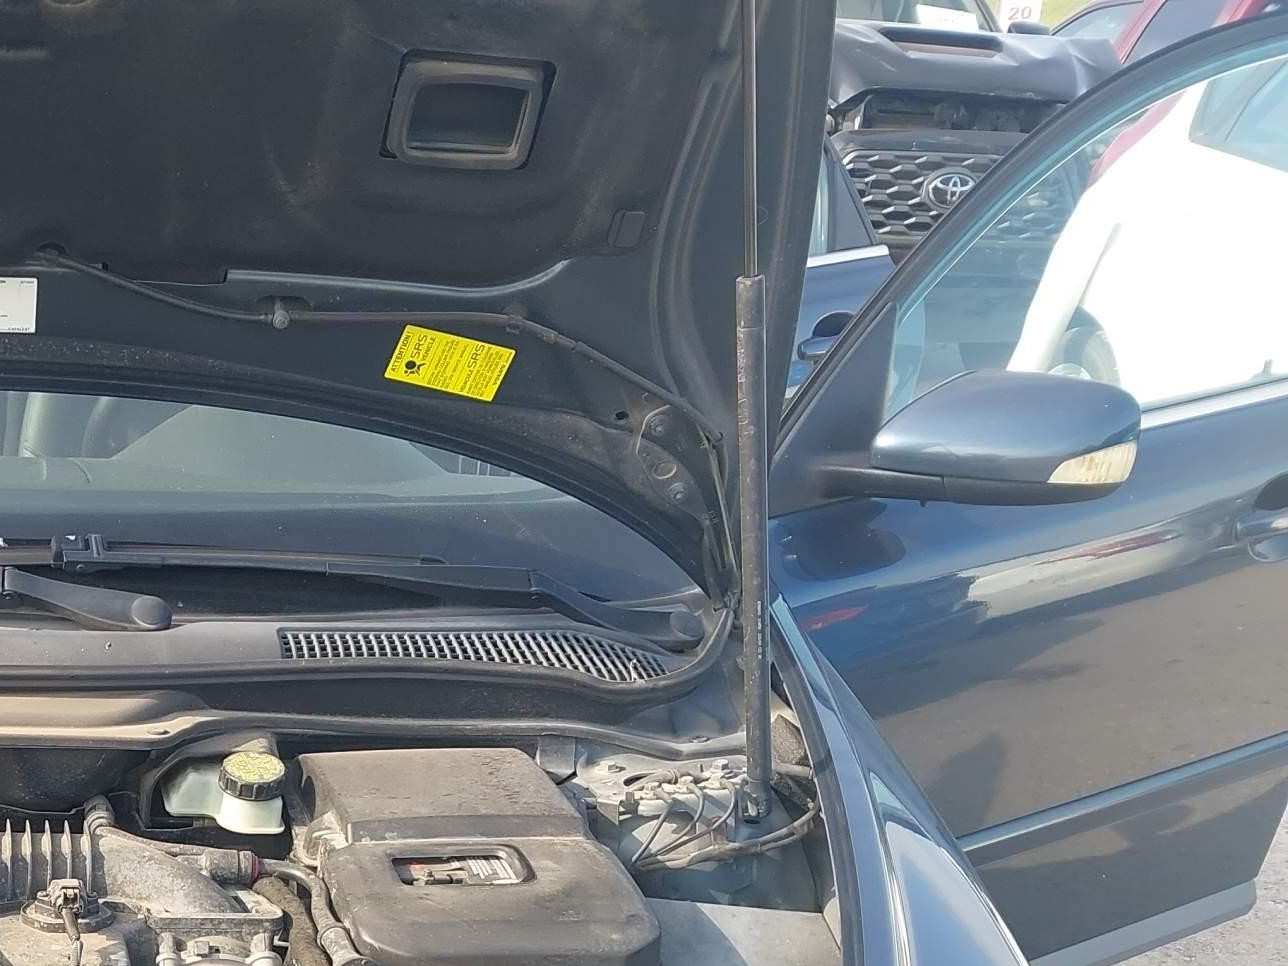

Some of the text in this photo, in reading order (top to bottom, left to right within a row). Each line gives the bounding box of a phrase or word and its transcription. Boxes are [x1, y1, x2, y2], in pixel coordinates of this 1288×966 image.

[1008, 6, 1032, 20] 20
[392, 335, 411, 372] ATTENTION
[411, 334, 428, 359] SRS
[467, 344, 485, 369] SRS
